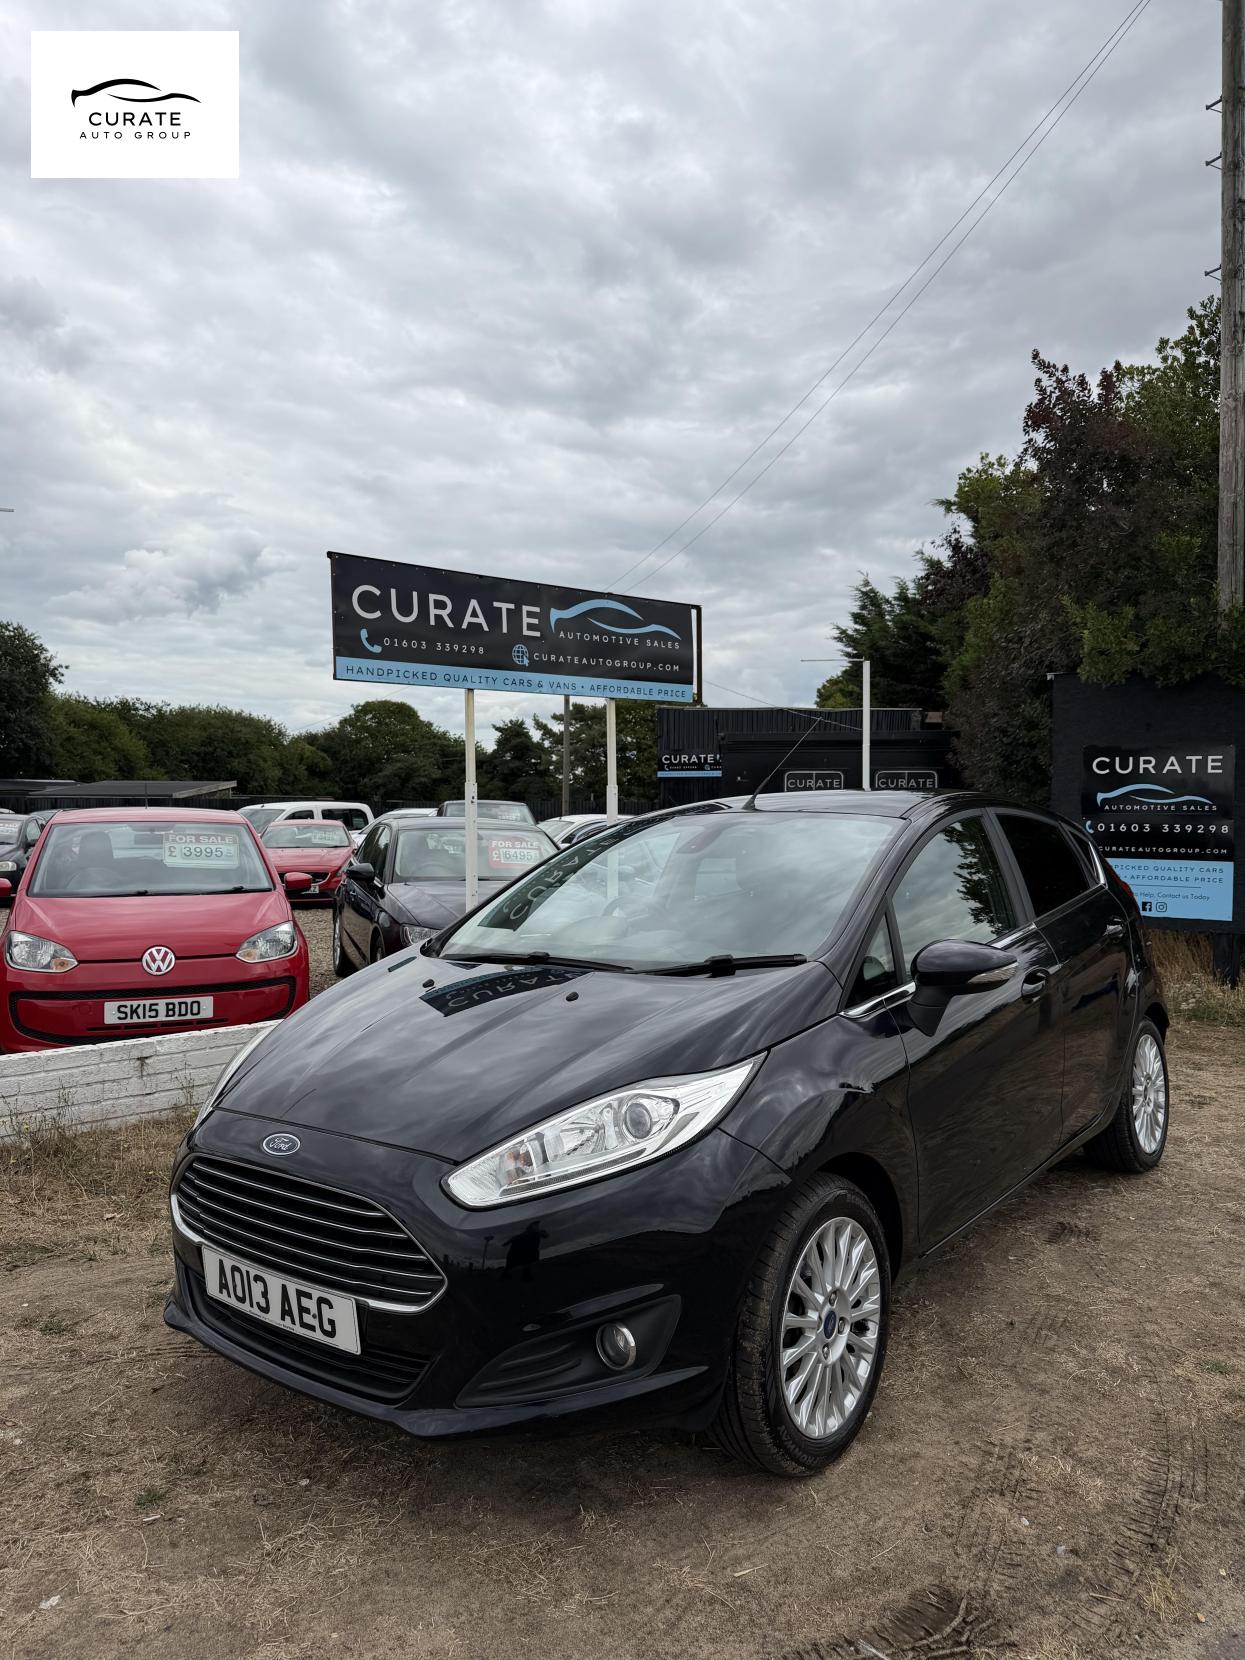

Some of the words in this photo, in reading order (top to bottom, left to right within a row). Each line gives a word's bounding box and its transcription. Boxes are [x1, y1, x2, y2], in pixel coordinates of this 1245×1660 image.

[352, 585, 541, 637] CURATE
[383, 637, 427, 649] 01603
[436, 643, 484, 654] 339298
[559, 631, 639, 646] AUTOMOTIVE
[646, 640, 680, 649] SALES
[533, 653, 679, 672] CURATEAUTOGROUP.COM
[346, 665, 437, 681] HANDPICKED
[443, 673, 498, 685] QUALITY
[503, 677, 532, 687] CARS
[537, 680, 543, 688] &
[549, 681, 577, 691] VANS
[590, 684, 653, 696] AFFORDABLE
[657, 689, 686, 698] PRICE
[662, 754, 715, 764] CURATE
[1092, 755, 1223, 774] CURATE
[787, 779, 841, 788] CURATE
[878, 778, 934, 788] CURATE
[1097, 823, 1150, 832] 01603
[1162, 824, 1229, 834] 339298
[169, 835, 195, 843] FOR
[199, 835, 233, 844] SALE
[491, 840, 513, 848] FOR
[514, 841, 540, 849] SALE
[183, 846, 224, 858] 3995
[1153, 865, 1195, 873] QUALITY
[1129, 874, 1190, 882] AFFORDABLE
[116, 1003, 159, 1021] SK15
[165, 1001, 201, 1018] BDO
[218, 1259, 271, 1315] AO13
[280, 1284, 338, 1340] AEG
